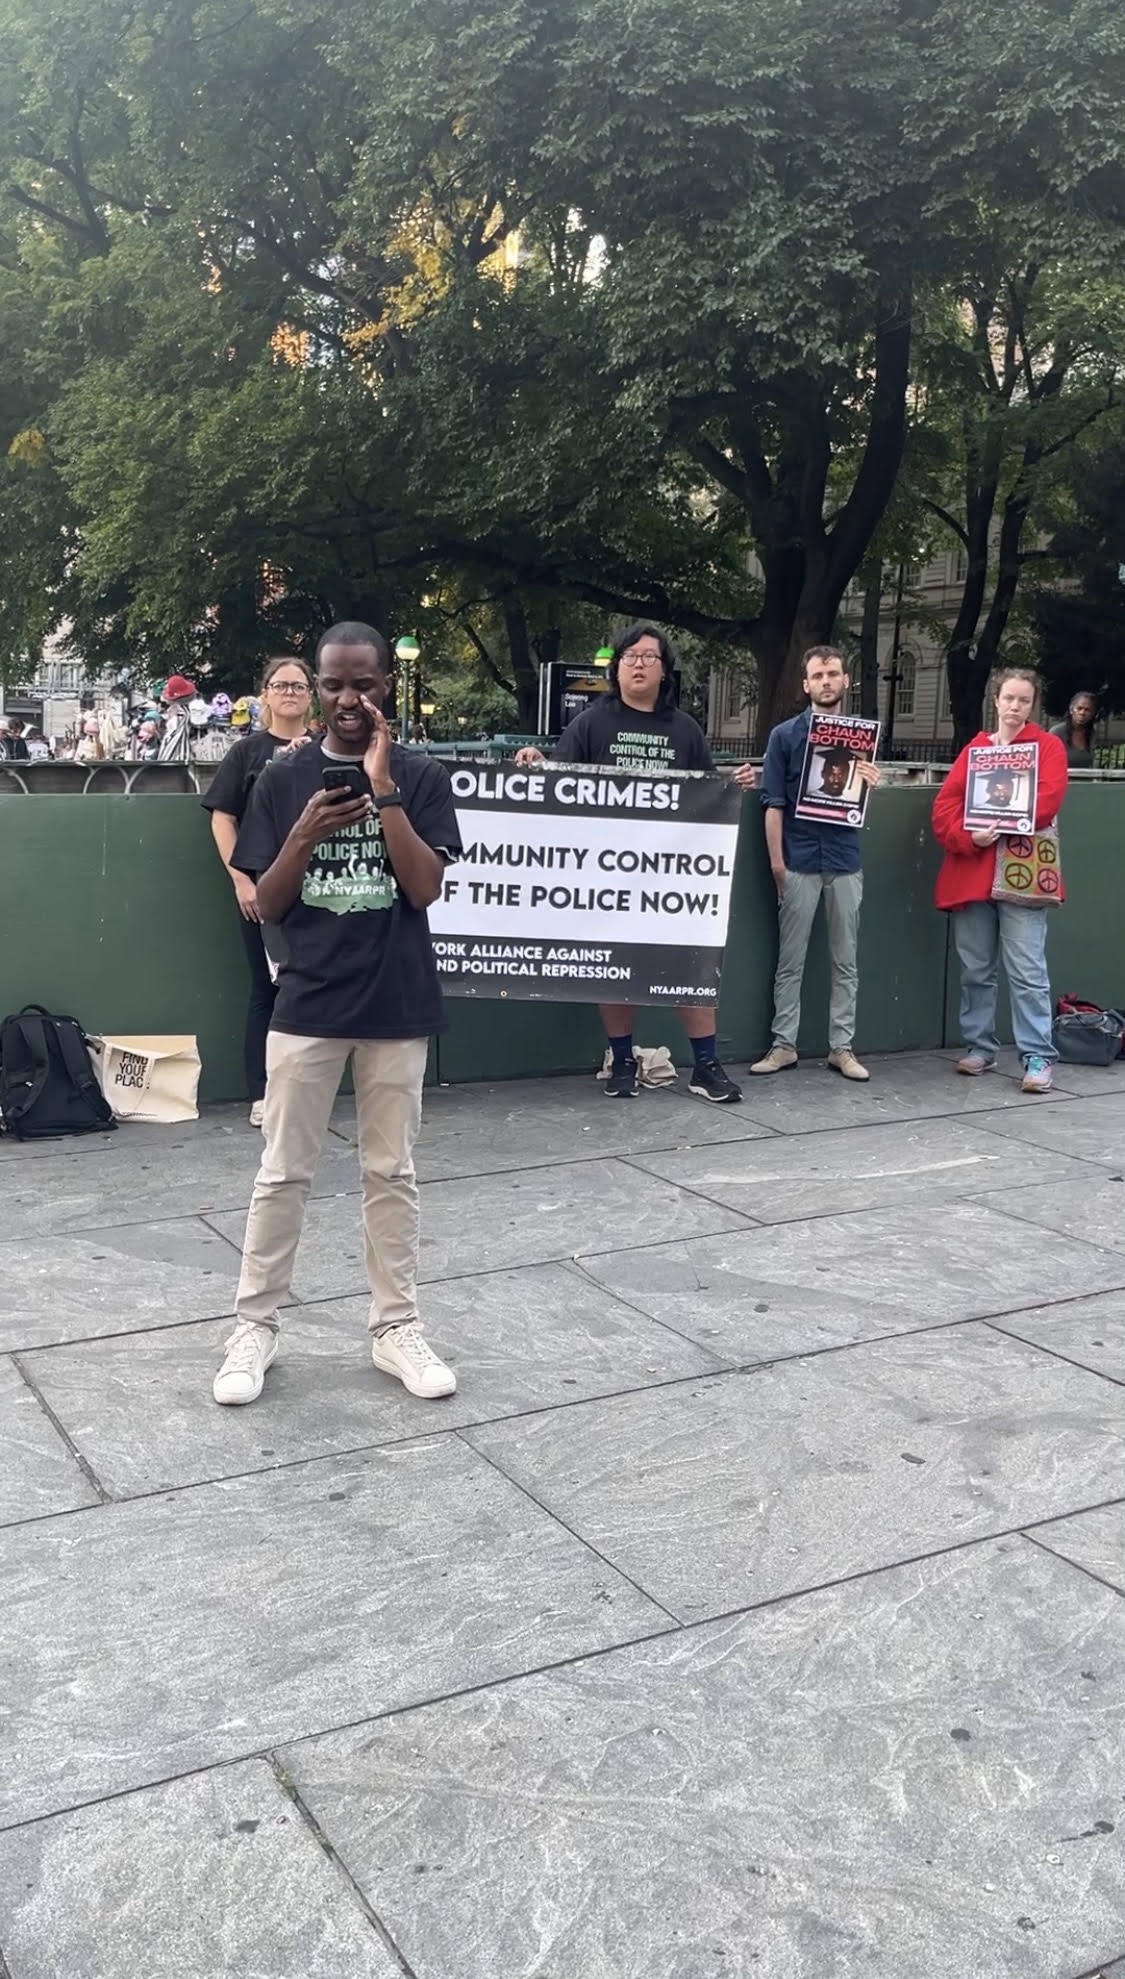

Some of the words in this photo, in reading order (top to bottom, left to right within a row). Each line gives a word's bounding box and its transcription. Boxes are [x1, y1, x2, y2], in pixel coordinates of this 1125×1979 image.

[816, 716, 853, 727] JUSTICE
[854, 721, 876, 730] FOR
[617, 732, 669, 746] COMMUNITY
[816, 724, 871, 740] CHAUN
[809, 733, 875, 751] BOTTOM
[609, 744, 647, 757] CONTROL
[648, 747, 659, 758] OF
[660, 748, 676, 760] THE
[973, 747, 1012, 755] JUSTICE
[976, 753, 1031, 763] CHAUN
[616, 757, 645, 769] POLICE
[970, 760, 1036, 771] BOTTOM
[450, 770, 546, 802] OLICE
[554, 777, 680, 810] CRIMES!
[598, 849, 730, 876] CONTROL
[444, 880, 459, 903] F
[468, 881, 521, 906] THE
[530, 885, 631, 911] POLICE
[640, 891, 719, 916] NOW!
[470, 944, 543, 960] ALLIANCE
[546, 947, 612, 963] AGAINST
[436, 959, 458, 972] ND
[461, 960, 538, 976] POLITICAL
[541, 964, 631, 980] REPRESSION
[649, 985, 717, 997] NYAARPR.ORG
[122, 1052, 149, 1065] FIND
